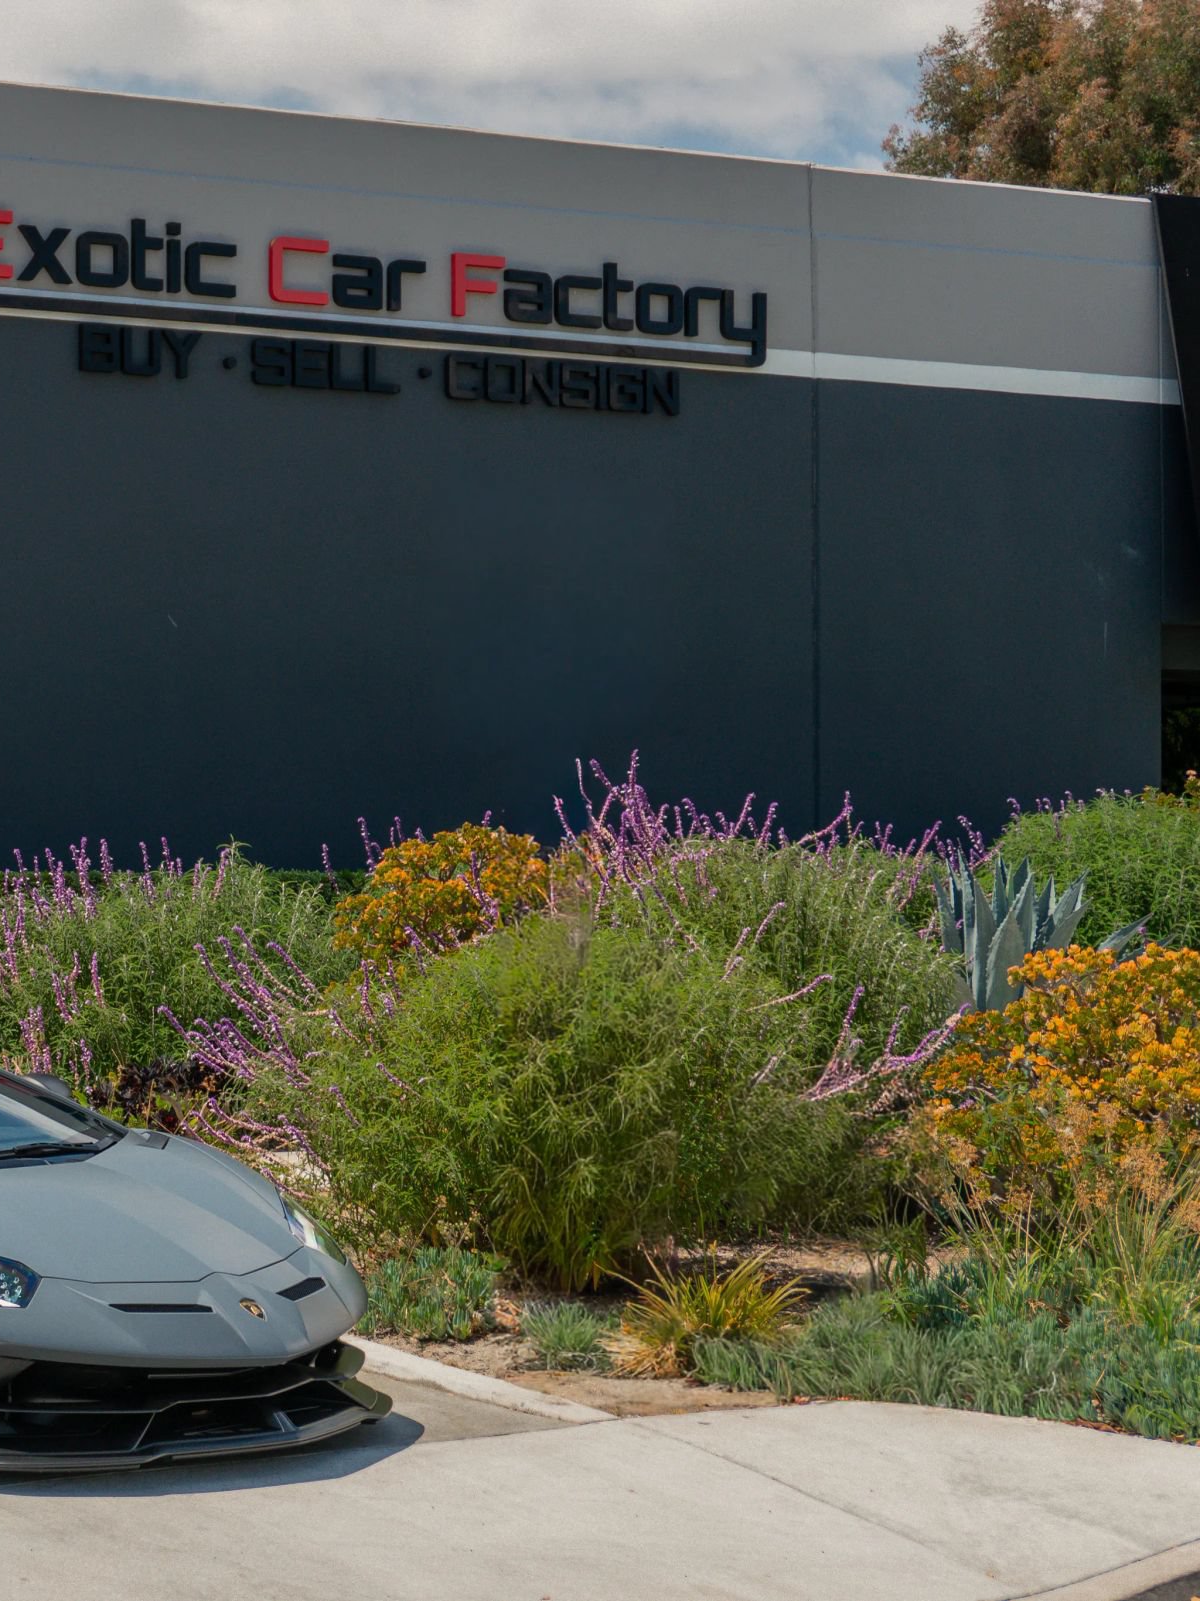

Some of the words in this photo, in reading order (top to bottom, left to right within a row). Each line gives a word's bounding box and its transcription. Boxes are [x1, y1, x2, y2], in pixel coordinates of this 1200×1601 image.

[269, 236, 426, 311] Car
[451, 252, 767, 367] Factory
[79, 323, 202, 379] BUY
[251, 337, 401, 394] SELL
[444, 353, 680, 416] CONSIGN
